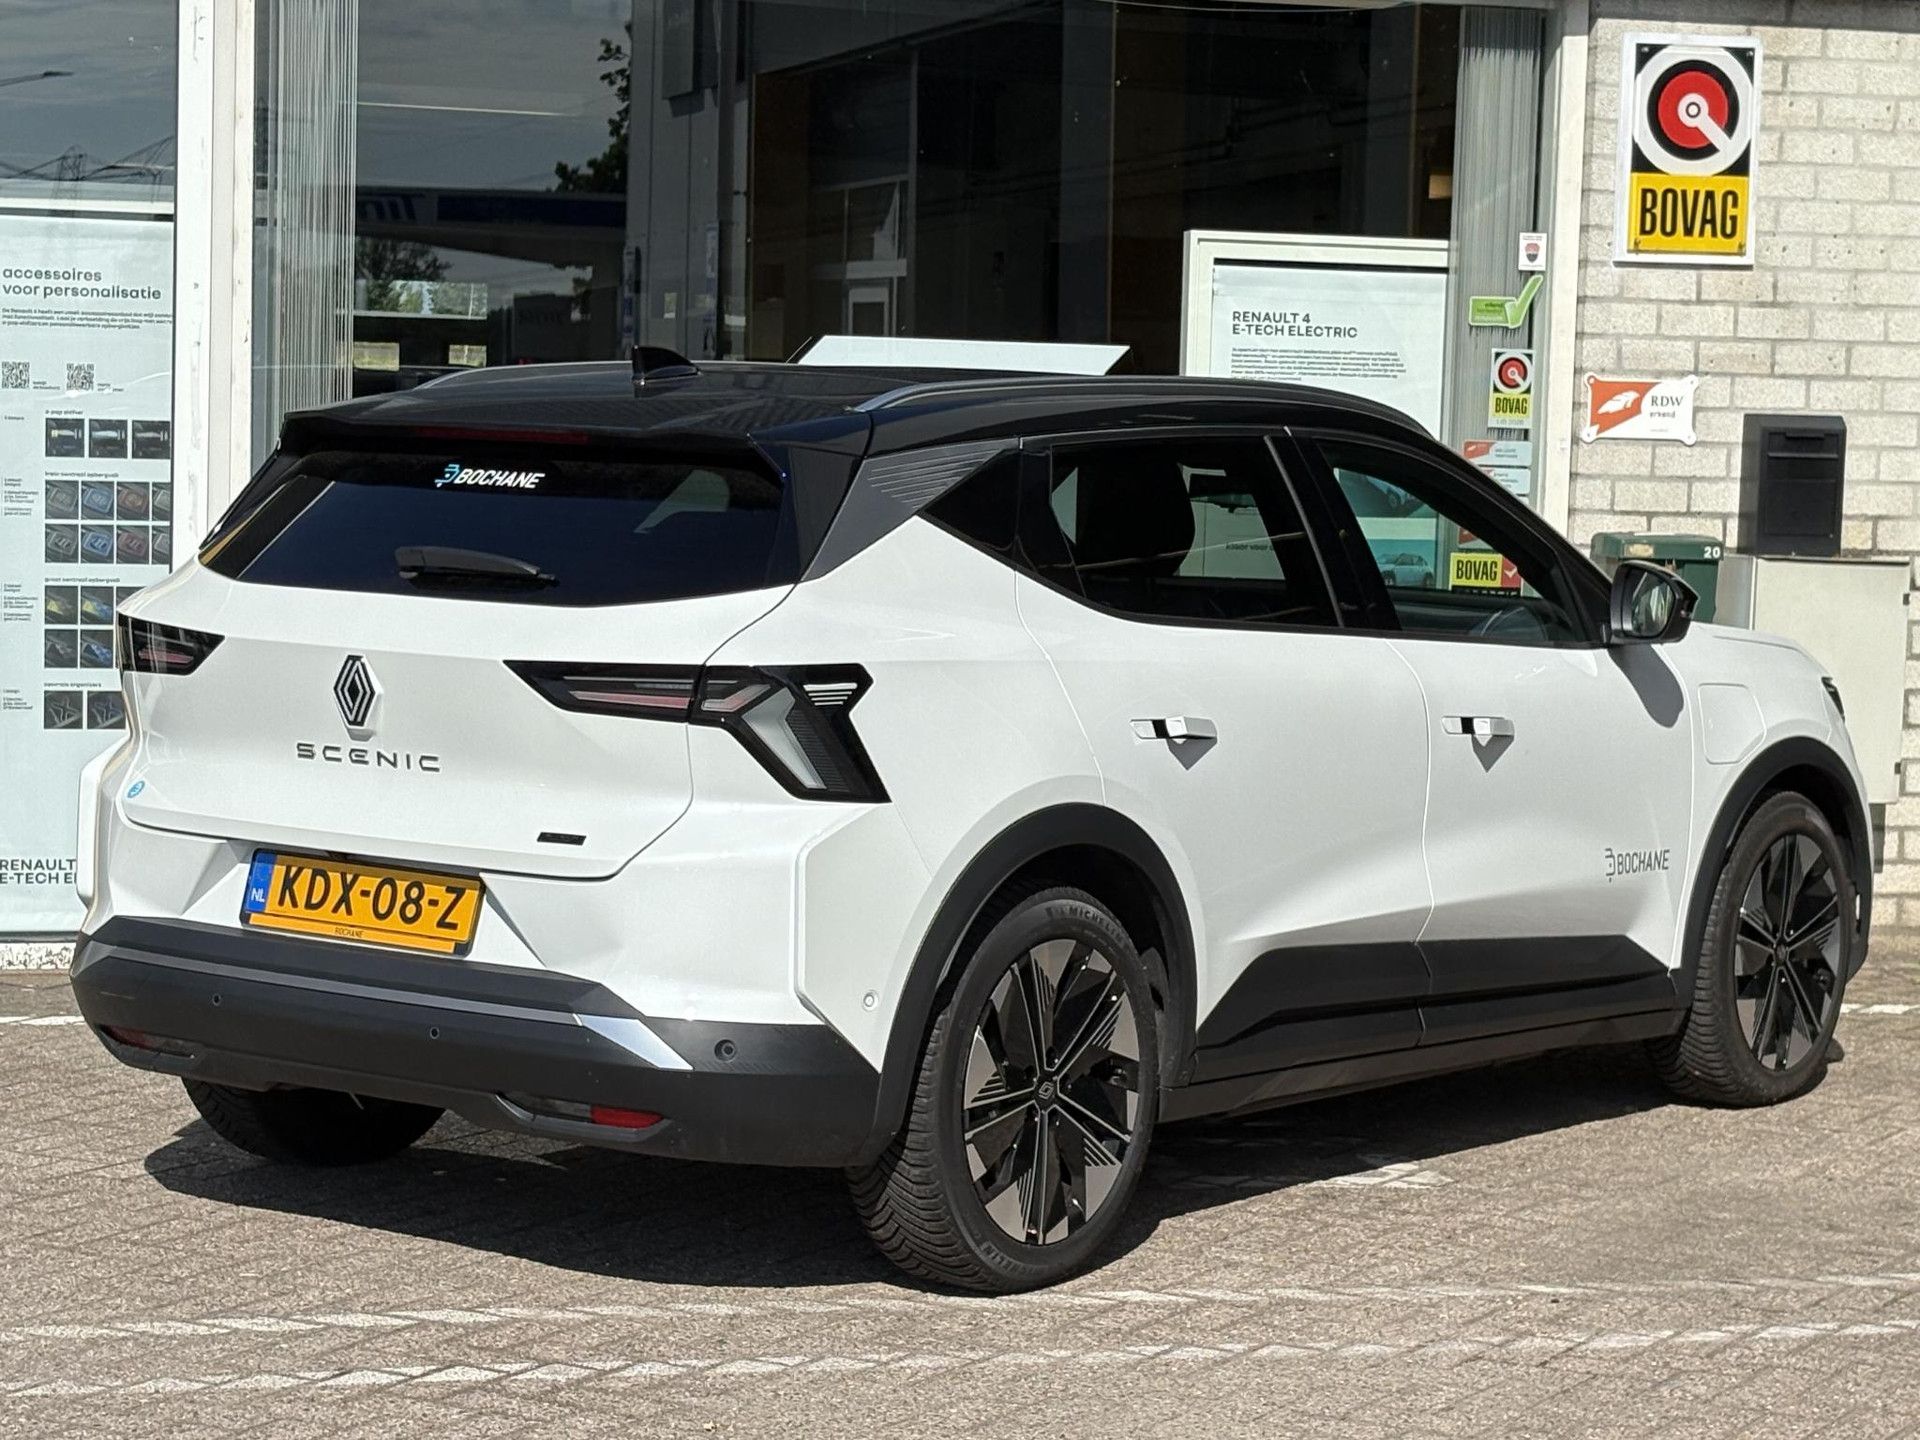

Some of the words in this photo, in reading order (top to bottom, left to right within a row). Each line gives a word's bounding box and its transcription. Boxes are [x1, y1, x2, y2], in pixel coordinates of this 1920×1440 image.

[1639, 187, 1740, 240] BOVAG
[2, 267, 103, 282] accessoires
[2, 284, 40, 296] voor
[43, 285, 162, 300] personalisatie
[1232, 311, 1299, 324] RENAULT
[1302, 313, 1311, 324] 4
[1232, 323, 1285, 336] E-TECH
[1288, 325, 1358, 339] ELECTRIC
[1494, 397, 1528, 415] BOVAG
[1650, 395, 1684, 407] RDW
[453, 468, 546, 489] BOCHANE
[1703, 546, 1721, 559] 20
[1456, 559, 1498, 582] BOVAG
[296, 742, 440, 773] SCENIC
[0, 858, 76, 871] RENAULT
[1617, 848, 1670, 875] BOCHANE
[0, 872, 59, 885] E-TECH
[251, 887, 265, 903] NL
[277, 864, 467, 931] KDX-08-Z
[334, 926, 364, 939] BOCHANE
